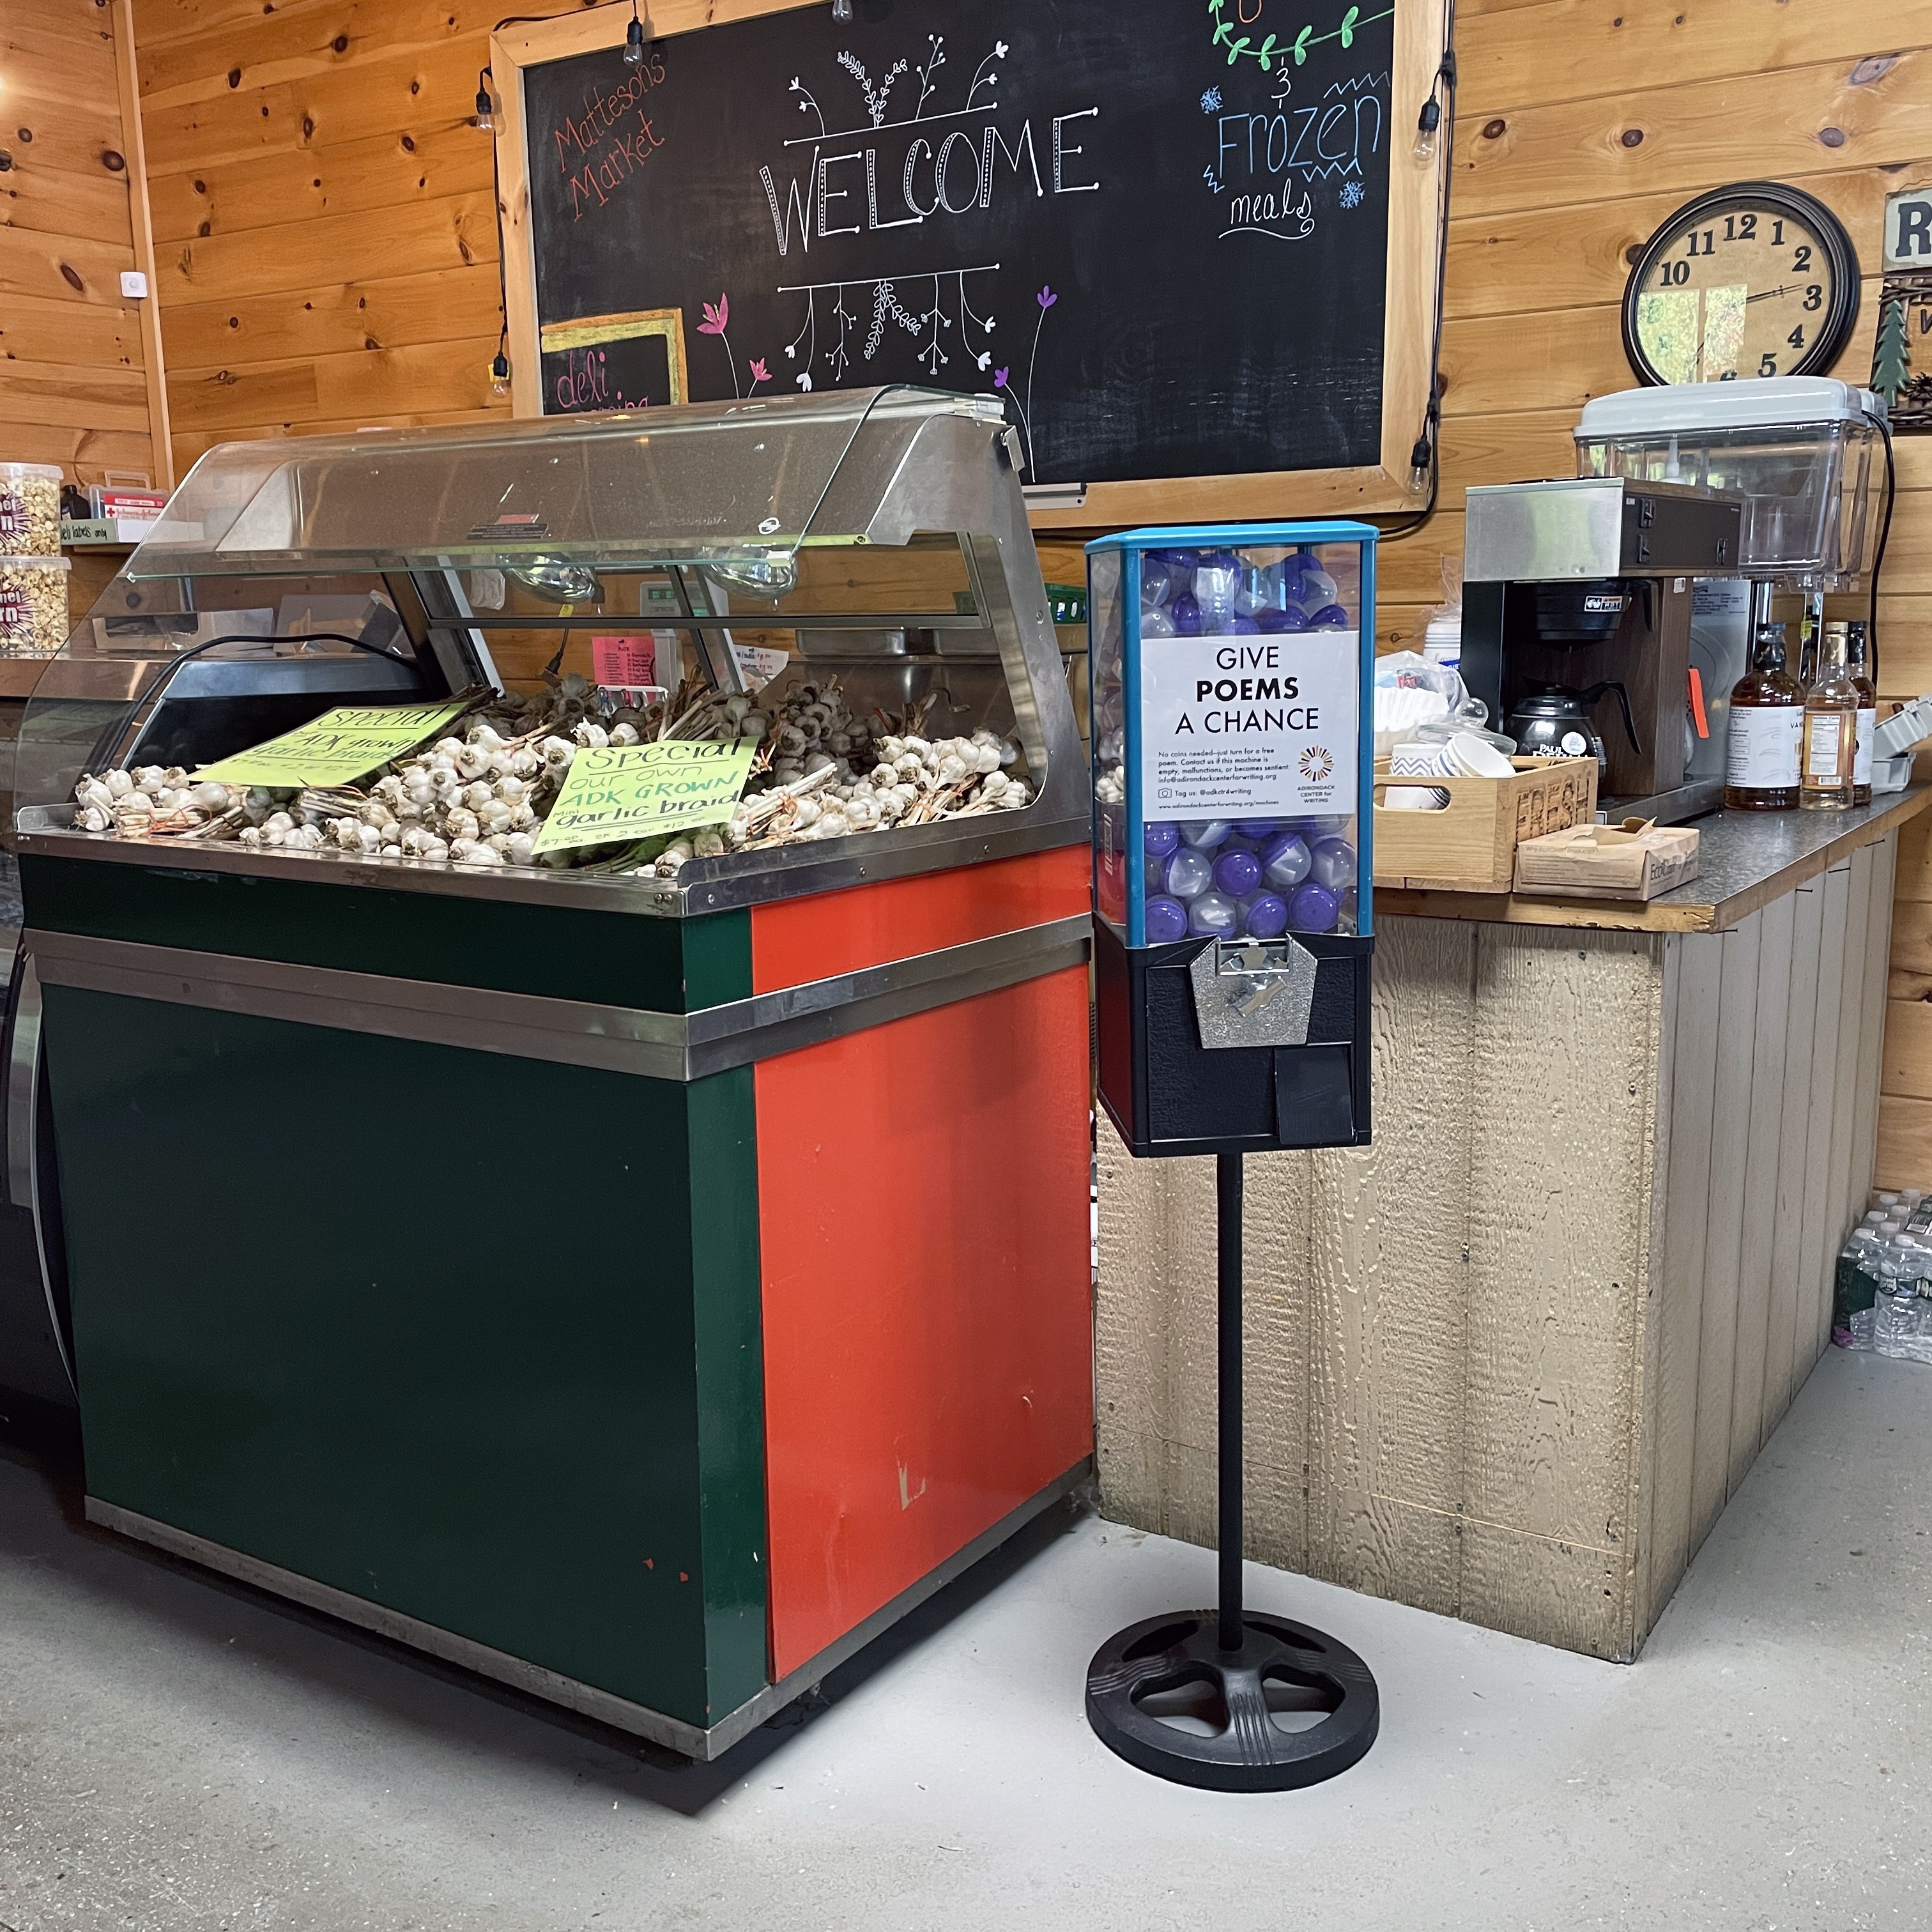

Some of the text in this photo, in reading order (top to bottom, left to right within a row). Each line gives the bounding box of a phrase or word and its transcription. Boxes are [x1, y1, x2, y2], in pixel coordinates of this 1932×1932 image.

[555, 54, 666, 173] Mattesons
[1218, 95, 1381, 179] Frozen
[570, 109, 666, 222] Market
[759, 107, 1100, 256] WELCOME
[1230, 178, 1313, 224] meals
[1723, 213, 1758, 241] 12
[1771, 220, 1785, 246] 1
[1687, 229, 1715, 256] 11
[1792, 245, 1812, 272] 2
[1660, 260, 1690, 286] 10
[1803, 284, 1822, 310] 3
[1788, 323, 1804, 349] 4
[557, 349, 609, 408] deli
[1758, 353, 1777, 377] 5
[72, 525, 91, 538] labels
[95, 528, 107, 540] only
[1216, 646, 1279, 670] GIVE
[1196, 677, 1299, 702] POEMS
[1175, 708, 1319, 735] A CHANCE
[246, 746, 326, 757] garlic
[294, 733, 417, 753] ADK grown
[586, 738, 741, 769] Special
[1540, 744, 1563, 753] PAUL
[559, 770, 739, 806] ADK GROWN
[570, 766, 702, 789] our own
[556, 790, 740, 829] garlic braid
[1514, 772, 1590, 850] FRESH
